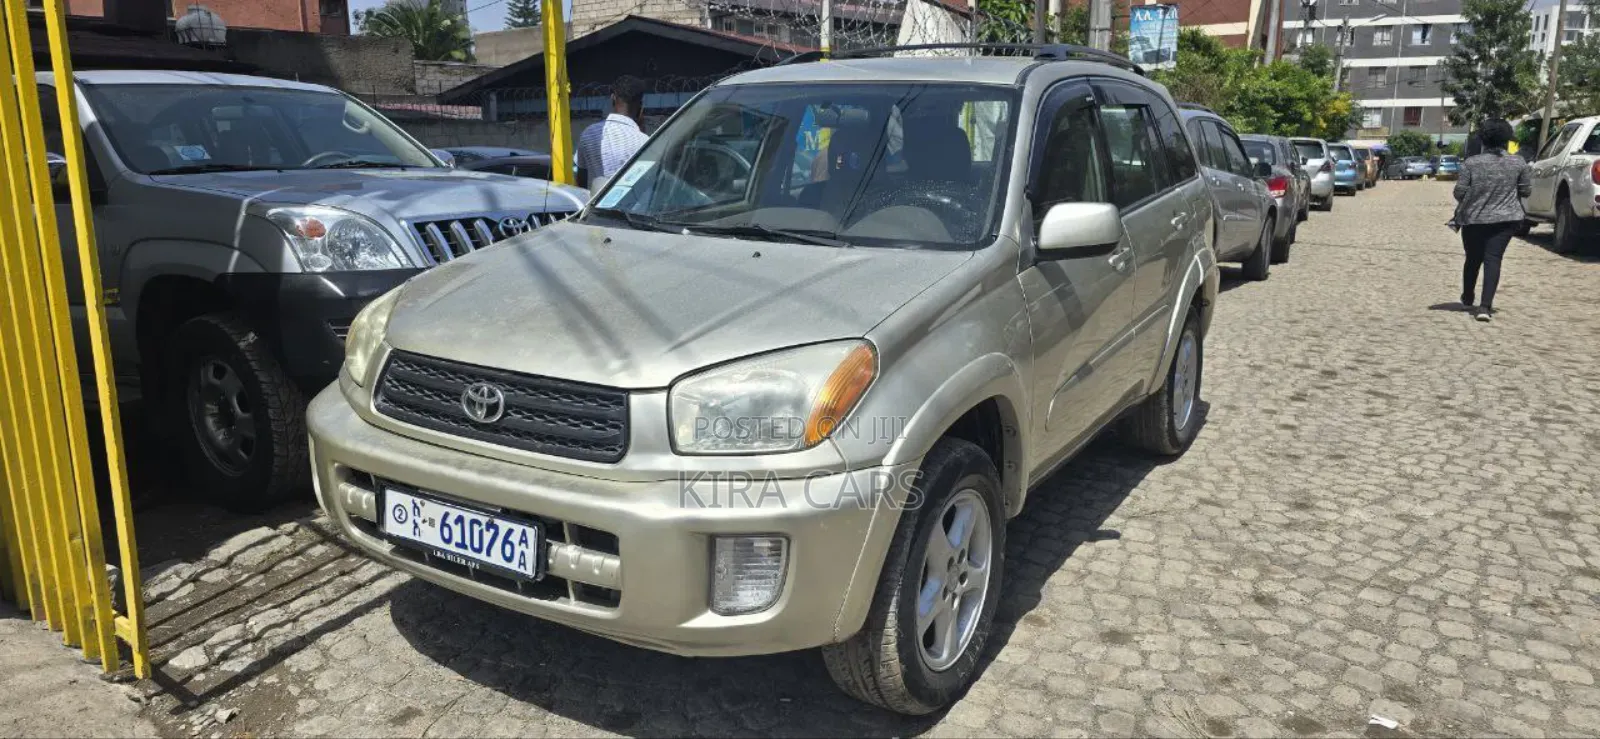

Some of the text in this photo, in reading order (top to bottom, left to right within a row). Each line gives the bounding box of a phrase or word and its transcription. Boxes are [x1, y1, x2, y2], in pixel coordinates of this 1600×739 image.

[440, 511, 515, 563] 61076
[519, 528, 529, 549] A
[518, 551, 527, 571] A
